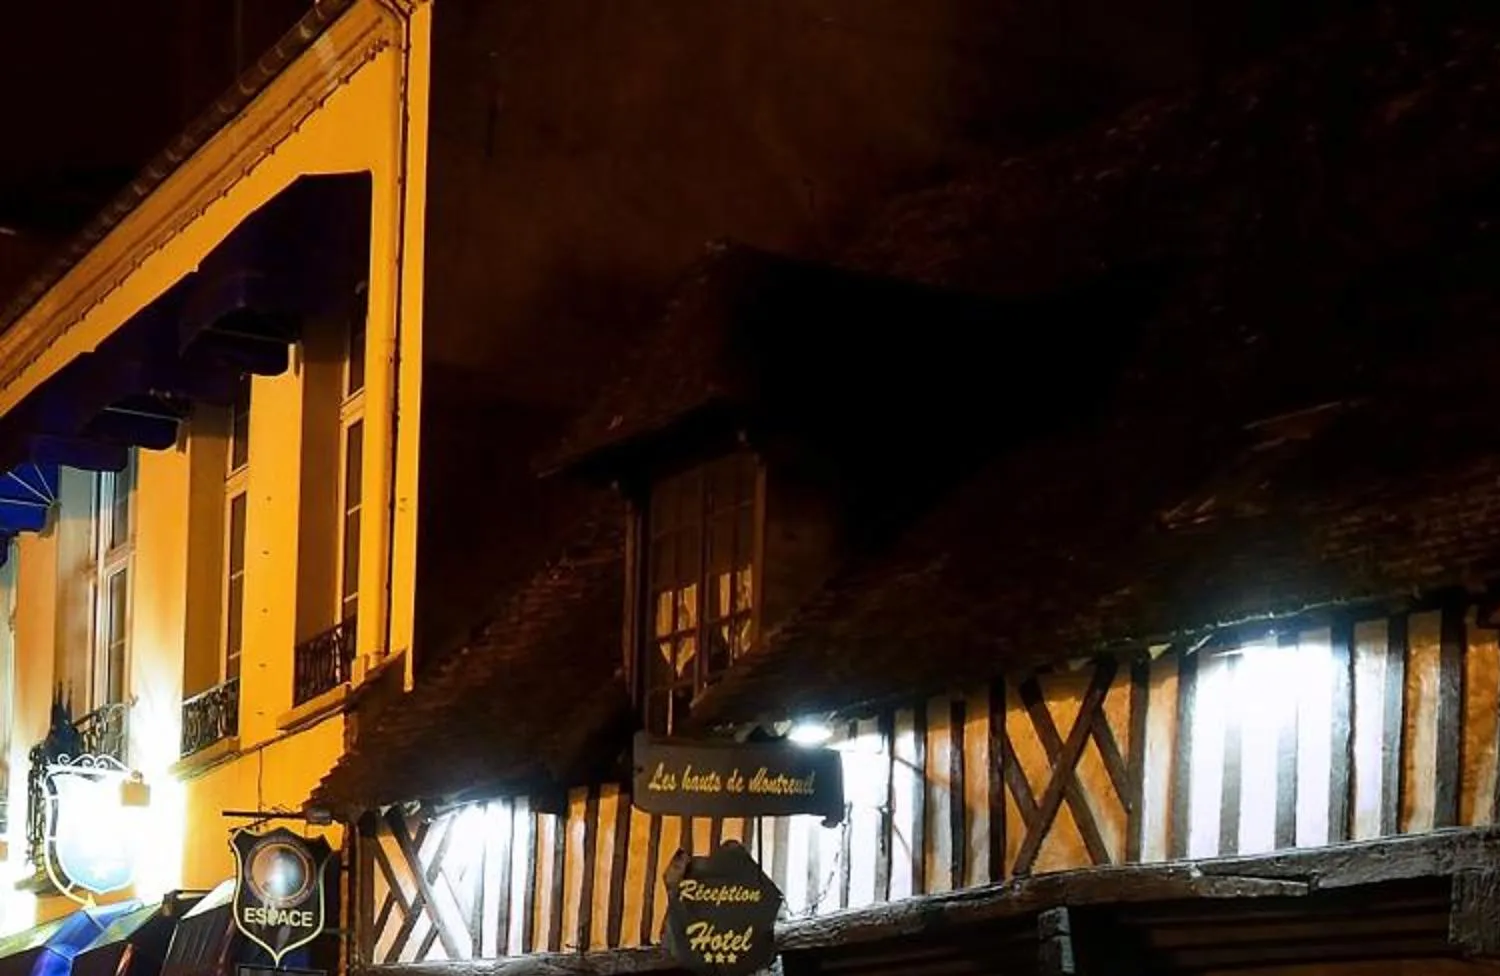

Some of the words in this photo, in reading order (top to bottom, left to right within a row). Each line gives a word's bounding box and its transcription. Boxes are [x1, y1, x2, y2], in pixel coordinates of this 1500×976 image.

[648, 762, 677, 793] Les
[681, 764, 722, 793] hauts
[726, 767, 745, 793] de
[244, 907, 314, 927] ESPACE
[686, 921, 753, 951] Hotel
